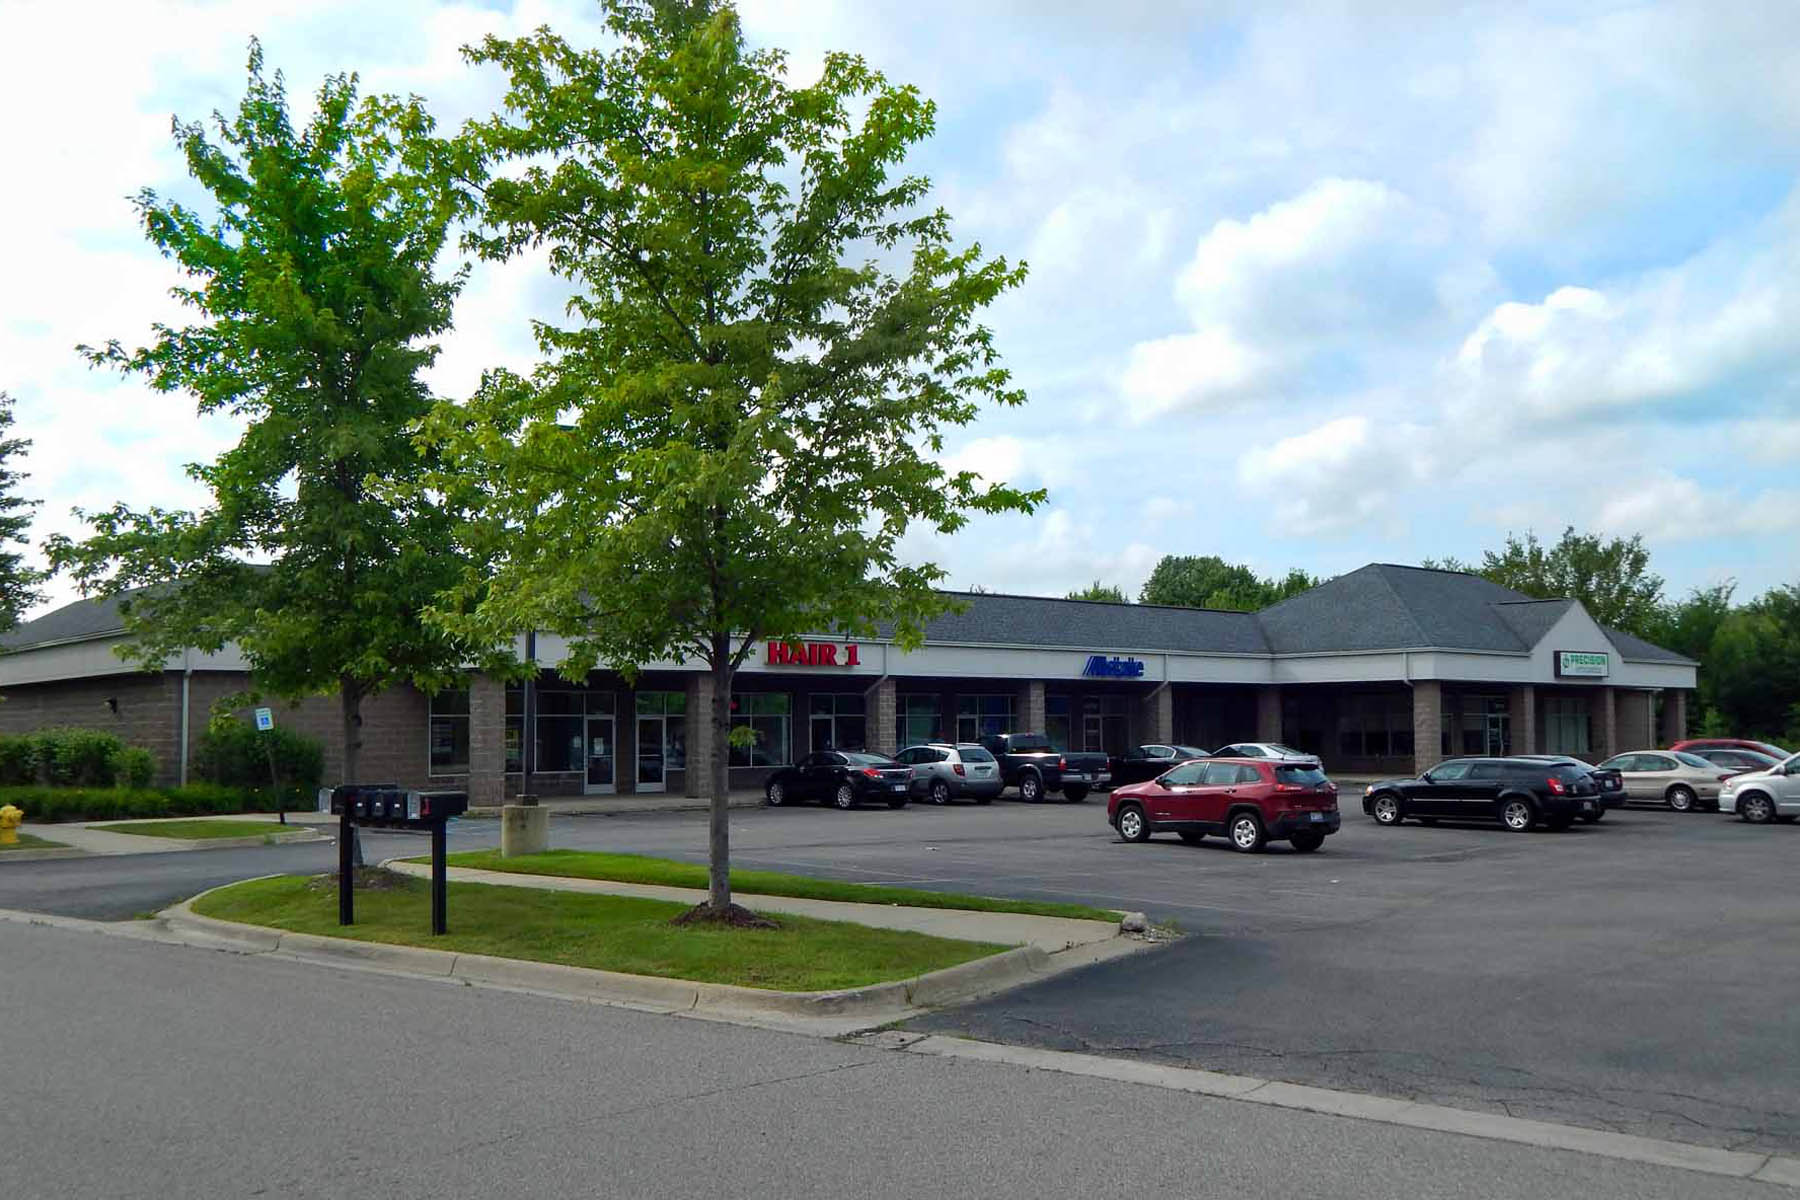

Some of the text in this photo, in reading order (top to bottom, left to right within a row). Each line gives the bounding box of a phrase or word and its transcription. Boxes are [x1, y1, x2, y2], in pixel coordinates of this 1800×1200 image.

[767, 641, 861, 666] HAIR 1
[1570, 654, 1607, 666] PRECISION
